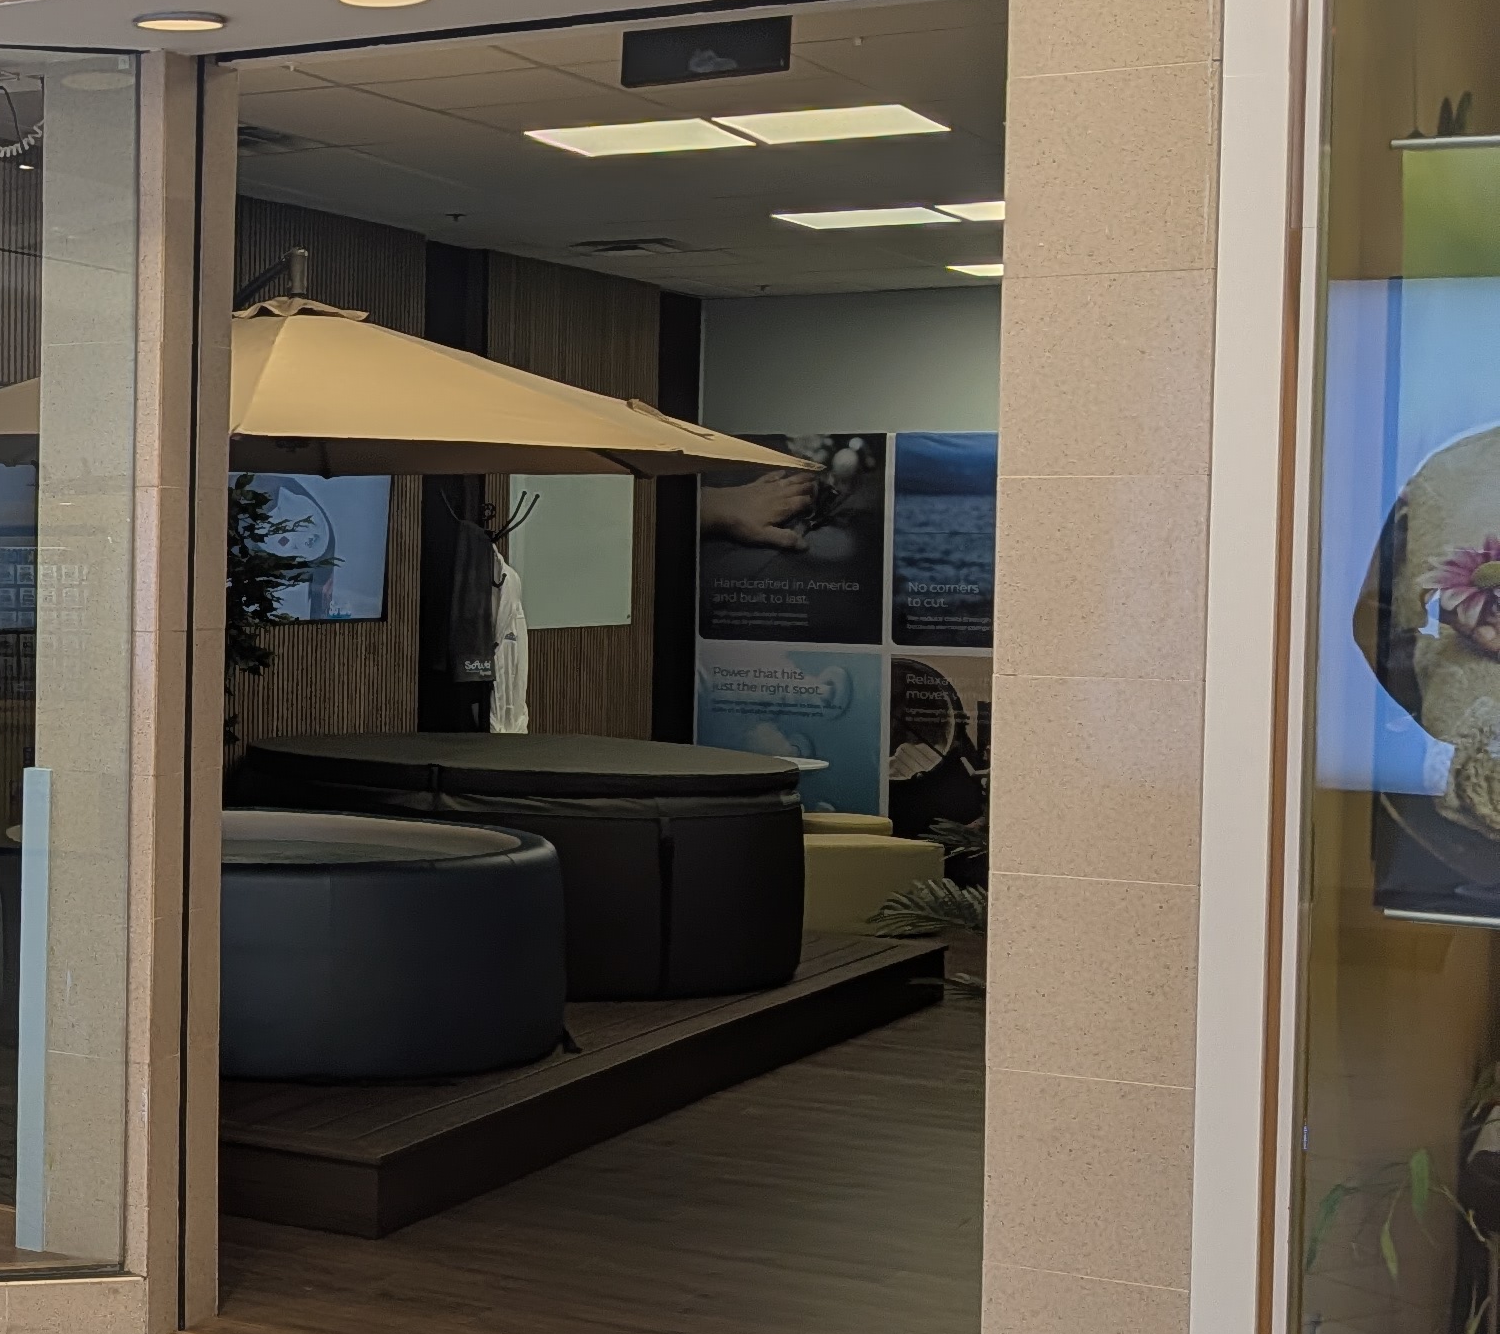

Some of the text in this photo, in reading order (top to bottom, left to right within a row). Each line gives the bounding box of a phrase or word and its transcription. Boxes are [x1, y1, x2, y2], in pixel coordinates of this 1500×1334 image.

[713, 578, 860, 591] Handcrafted in America
[908, 581, 980, 594] No corners
[712, 592, 737, 603] and
[740, 592, 767, 604] built
[770, 594, 783, 604] to
[907, 597, 949, 608] to cut.
[713, 666, 804, 680] Power that hits
[711, 682, 734, 693] just
[736, 682, 757, 692] the
[760, 683, 790, 696] right
